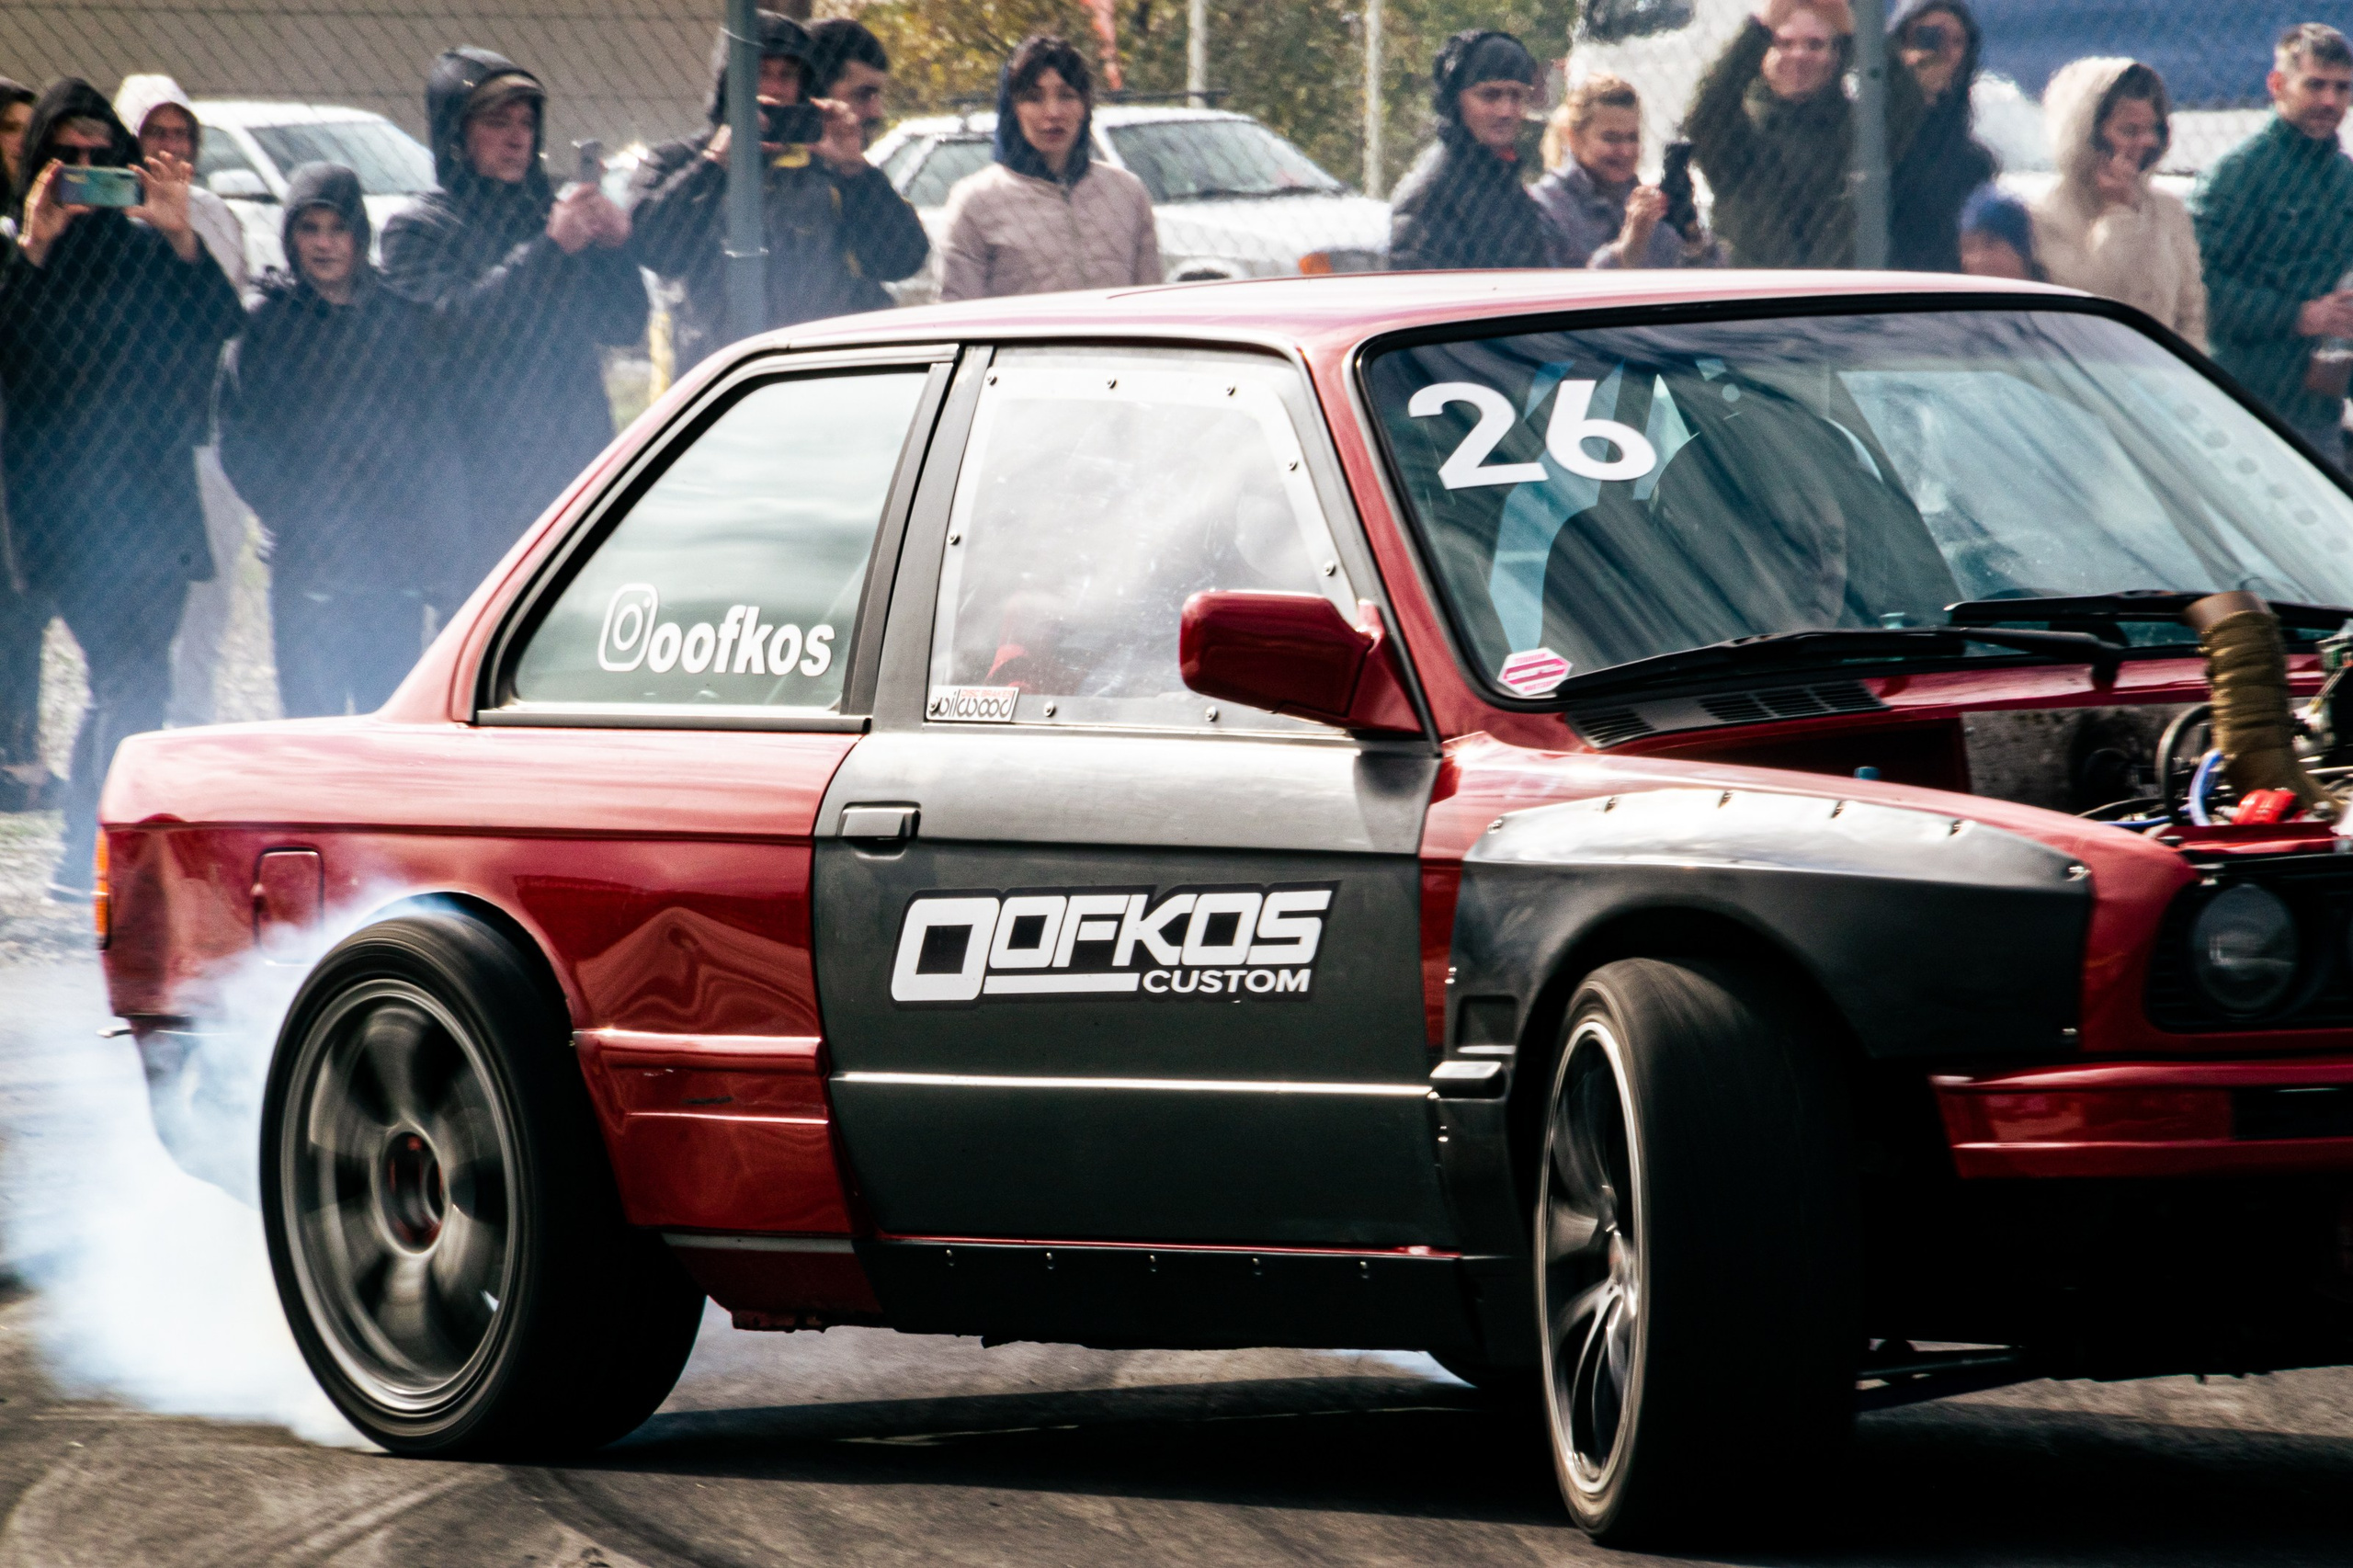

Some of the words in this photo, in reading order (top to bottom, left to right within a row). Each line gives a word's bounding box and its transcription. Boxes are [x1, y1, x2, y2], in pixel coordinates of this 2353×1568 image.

[1408, 380, 1657, 490] 26
[647, 604, 835, 677] oofkos
[891, 890, 1333, 1002] OOFKOS
[1142, 968, 1312, 994] CUSTOM
